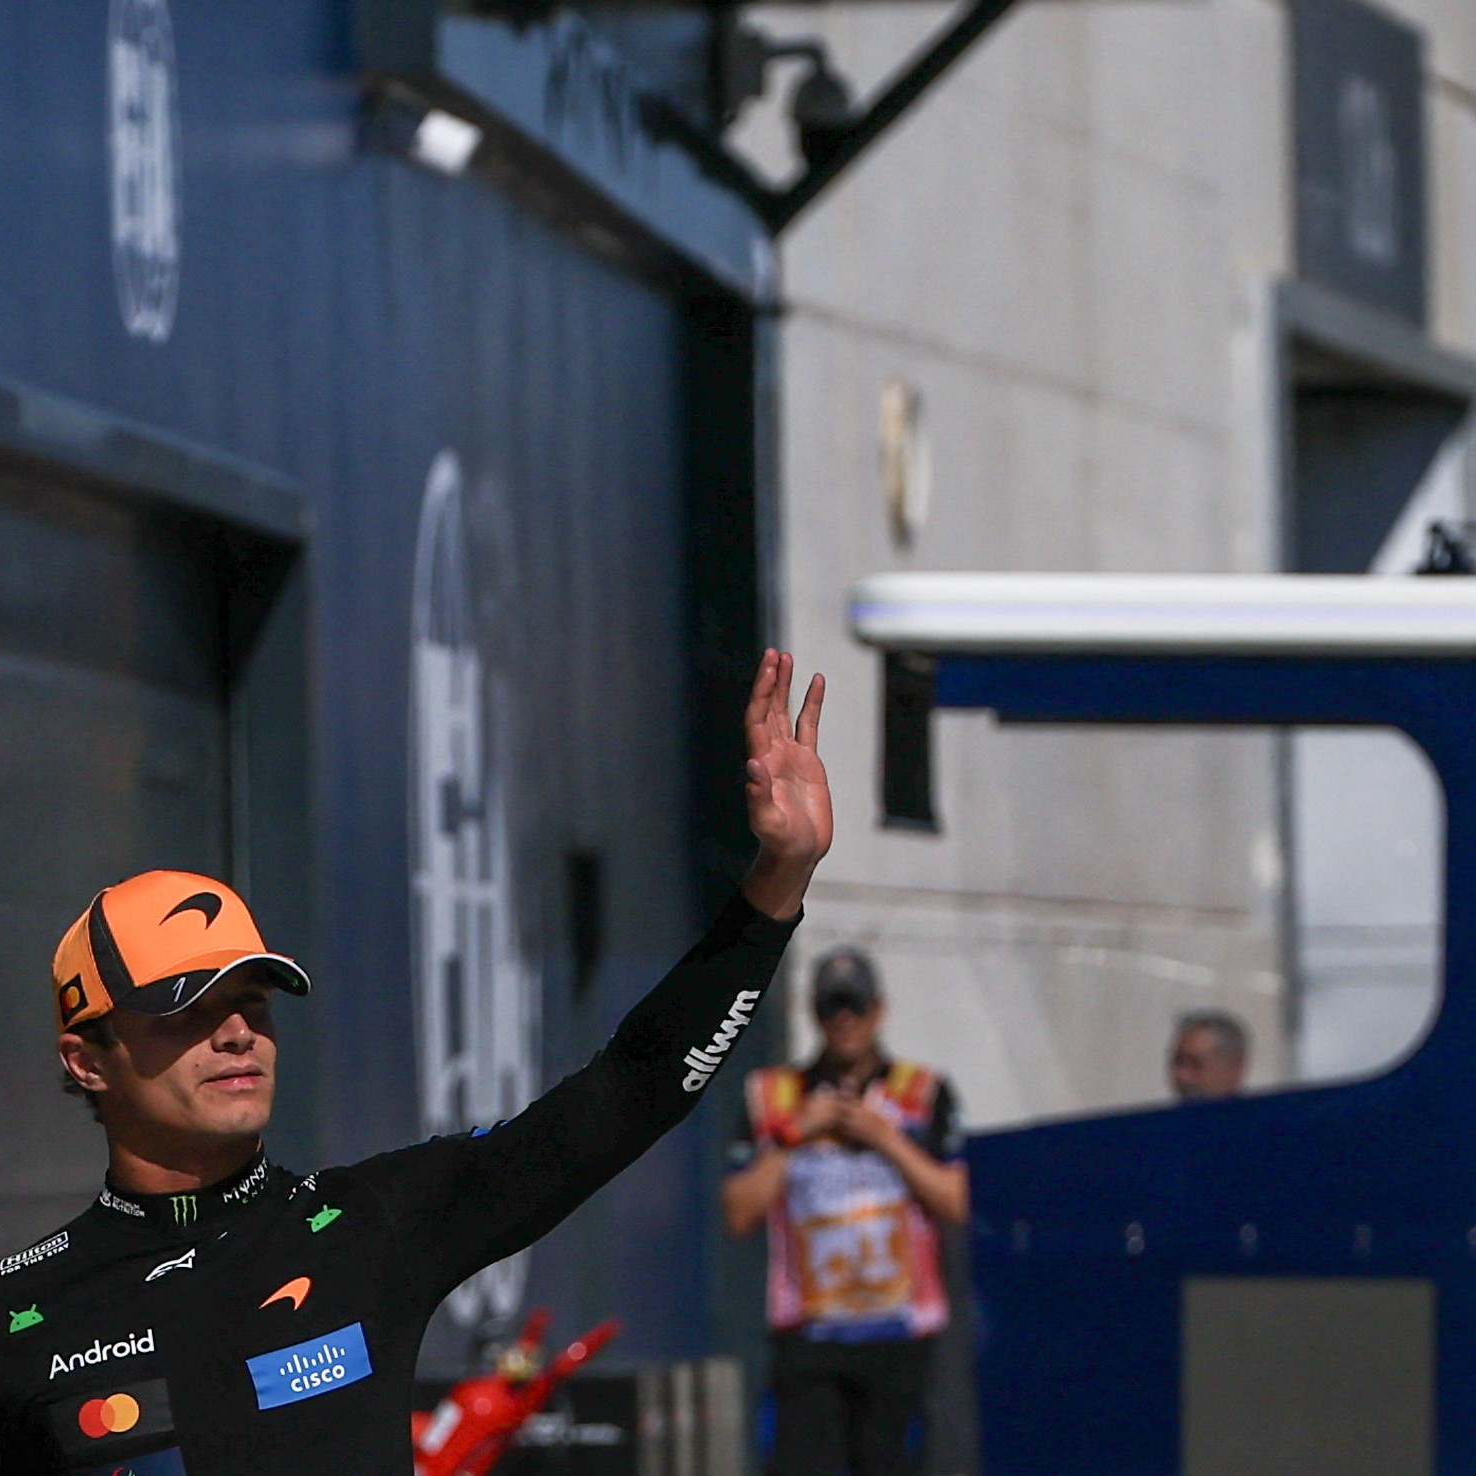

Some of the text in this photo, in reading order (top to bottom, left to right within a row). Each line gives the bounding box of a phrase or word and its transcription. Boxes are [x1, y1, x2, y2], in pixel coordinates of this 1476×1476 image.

[0, 1242, 69, 1276] FOR THE STAY
[6, 1237, 63, 1266] Hilton
[49, 1328, 155, 1380] Android
[290, 1364, 346, 1393] CISCO
